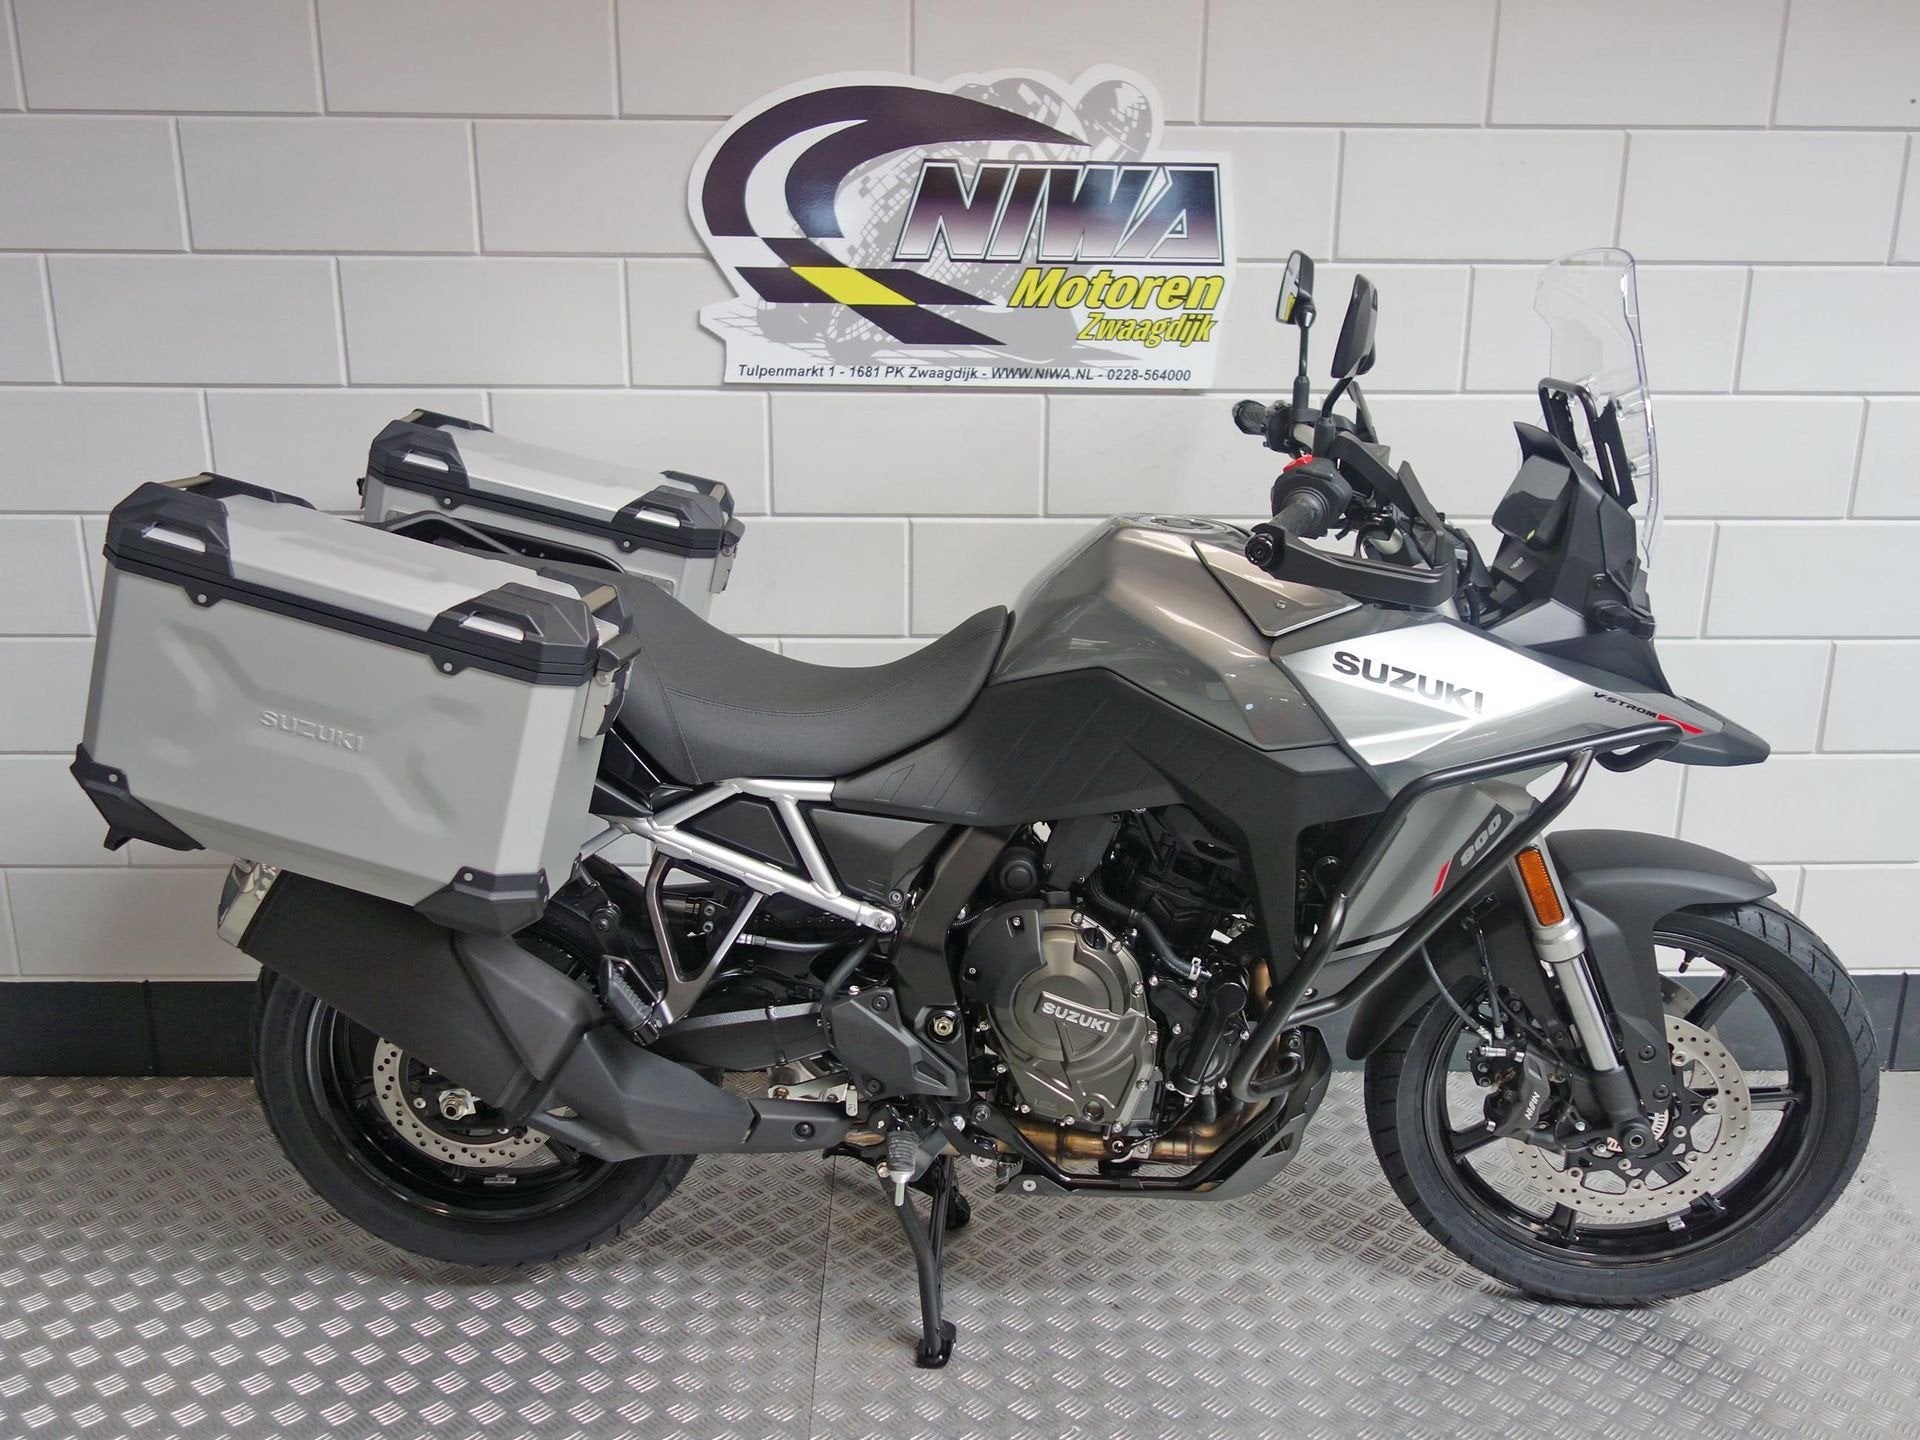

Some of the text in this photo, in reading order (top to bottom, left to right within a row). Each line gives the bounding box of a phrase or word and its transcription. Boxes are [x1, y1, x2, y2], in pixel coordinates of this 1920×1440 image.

[892, 159, 1225, 266] NIWA
[1007, 267, 1225, 311] Motoren
[1077, 312, 1218, 348] Zwaagdijk
[738, 364, 825, 380] Tulpenmarkt
[827, 365, 835, 378] 1
[849, 365, 880, 378] 1681
[884, 366, 905, 378] PK
[908, 366, 978, 382] Zwaagdijk
[991, 367, 1094, 380] WWW.NIWA.NL
[1106, 369, 1192, 382] 0228-564000
[1332, 651, 1484, 714] SUZUKI
[260, 710, 364, 752] SUZUKI
[1460, 813, 1502, 867] 800
[1042, 1002, 1111, 1033] SUZUKI
